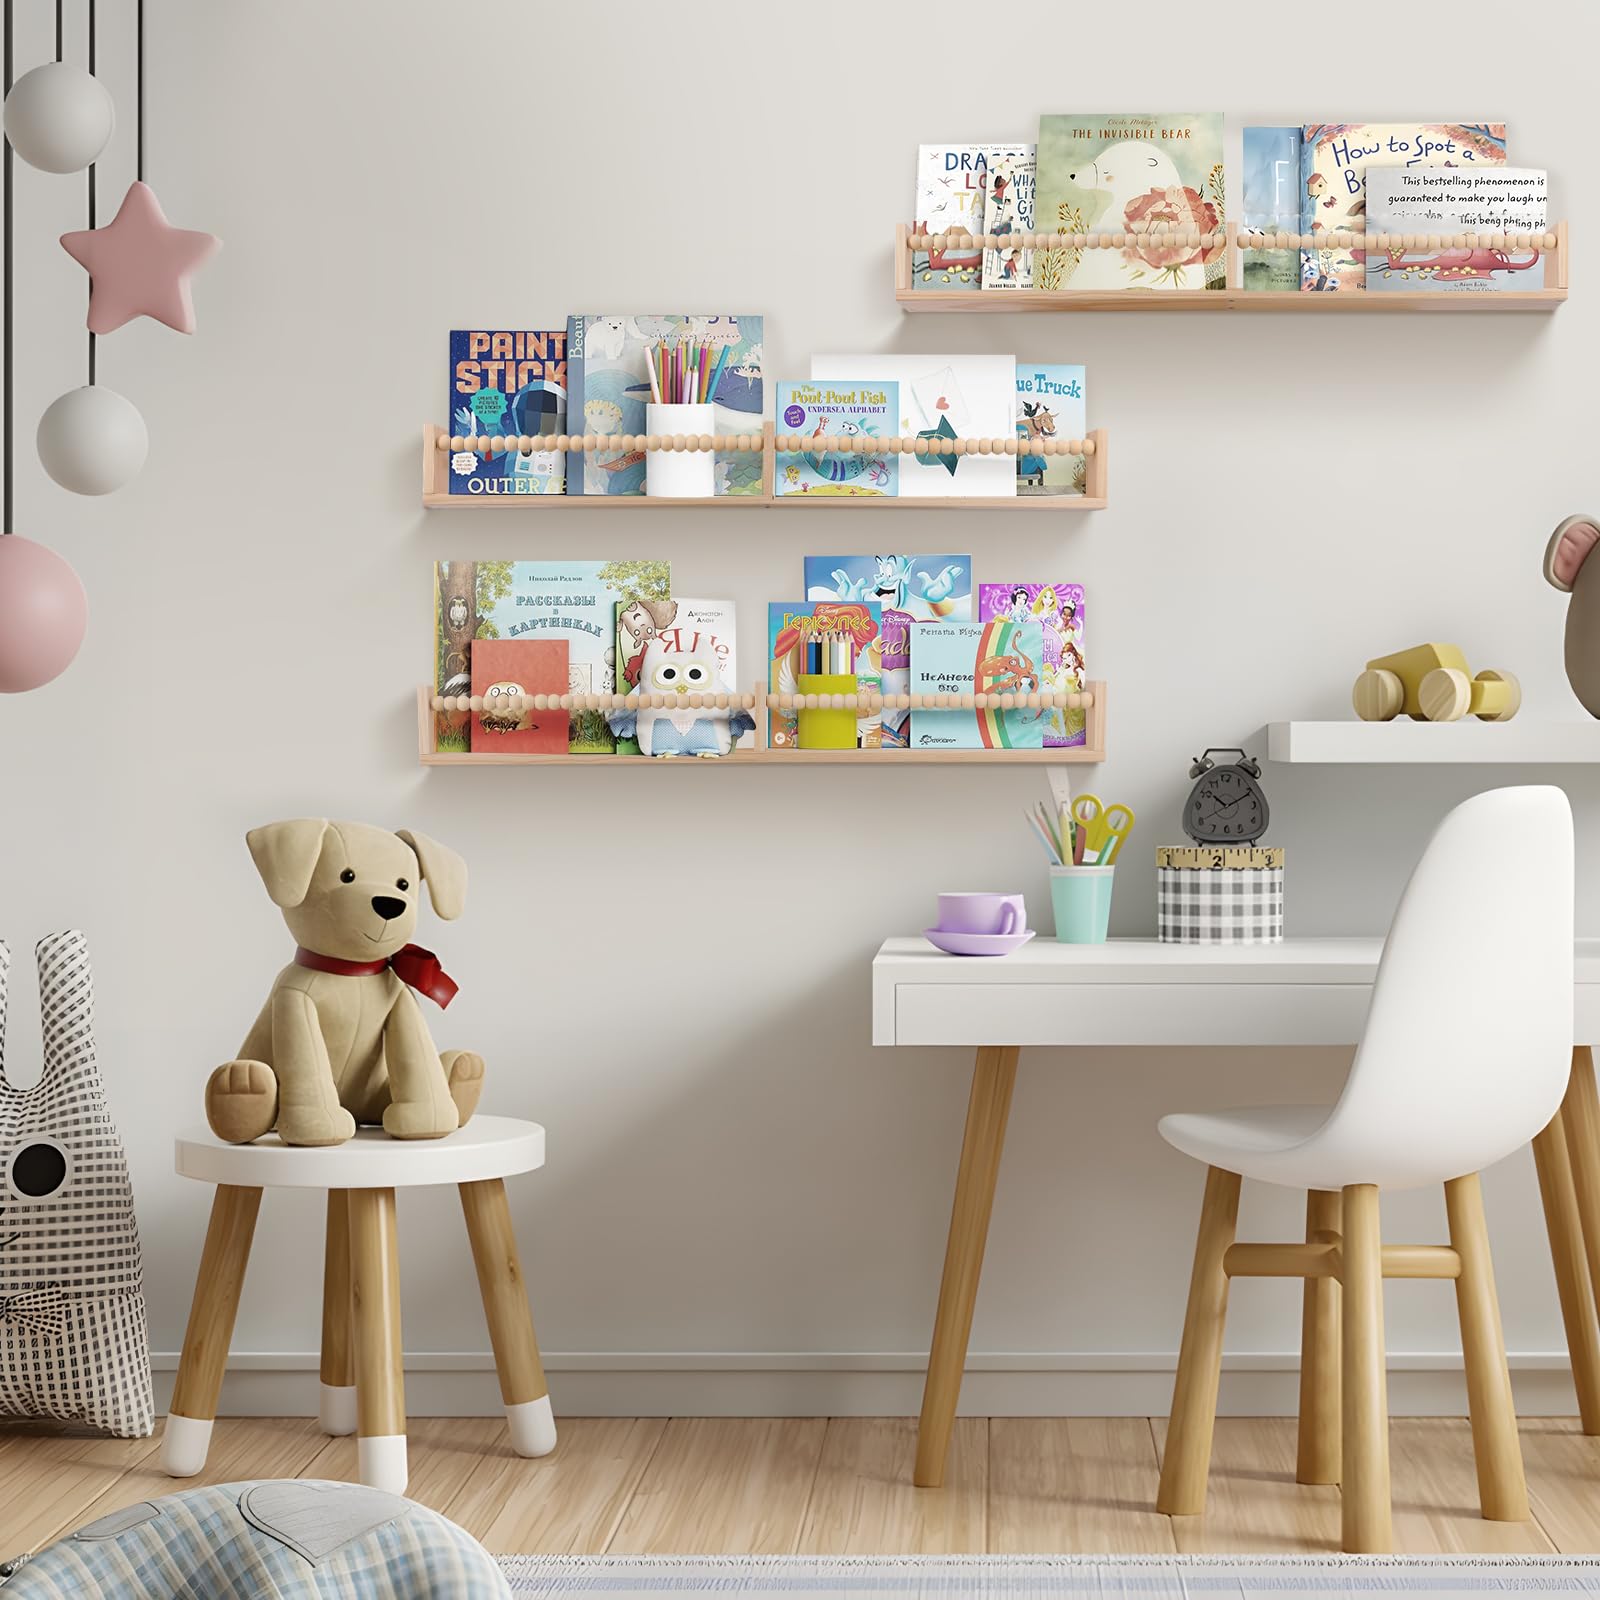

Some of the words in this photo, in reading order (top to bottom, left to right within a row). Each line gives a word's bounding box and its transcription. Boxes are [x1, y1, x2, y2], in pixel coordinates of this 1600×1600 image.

[1072, 129, 1091, 139] THE
[1099, 129, 1155, 139] INVISIBLE
[1161, 128, 1191, 139] BEAR
[1332, 138, 1380, 167] How
[1386, 136, 1409, 152] to
[1412, 135, 1456, 157] Spot
[1462, 149, 1475, 161] a
[1402, 176, 1421, 186] This
[1423, 176, 1472, 188] bestselling
[1475, 176, 1535, 188] phenomenon
[1537, 176, 1544, 186] is
[1388, 193, 1443, 205] guaranteed
[1446, 194, 1456, 202] to
[1458, 193, 1485, 203] make
[1488, 195, 1504, 206] you
[1507, 193, 1533, 205] laugh
[469, 332, 567, 359] PAINT
[1015, 378, 1033, 392] ue
[1034, 373, 1081, 399] Truck
[791, 390, 857, 404] Pout-Pout
[860, 390, 887, 405] Fish
[468, 478, 539, 494] OUTER
[516, 595, 596, 606] РАССКАЗЫ
[508, 617, 604, 637] КАРТИНКАХ
[1212, 855, 1222, 867] 2
